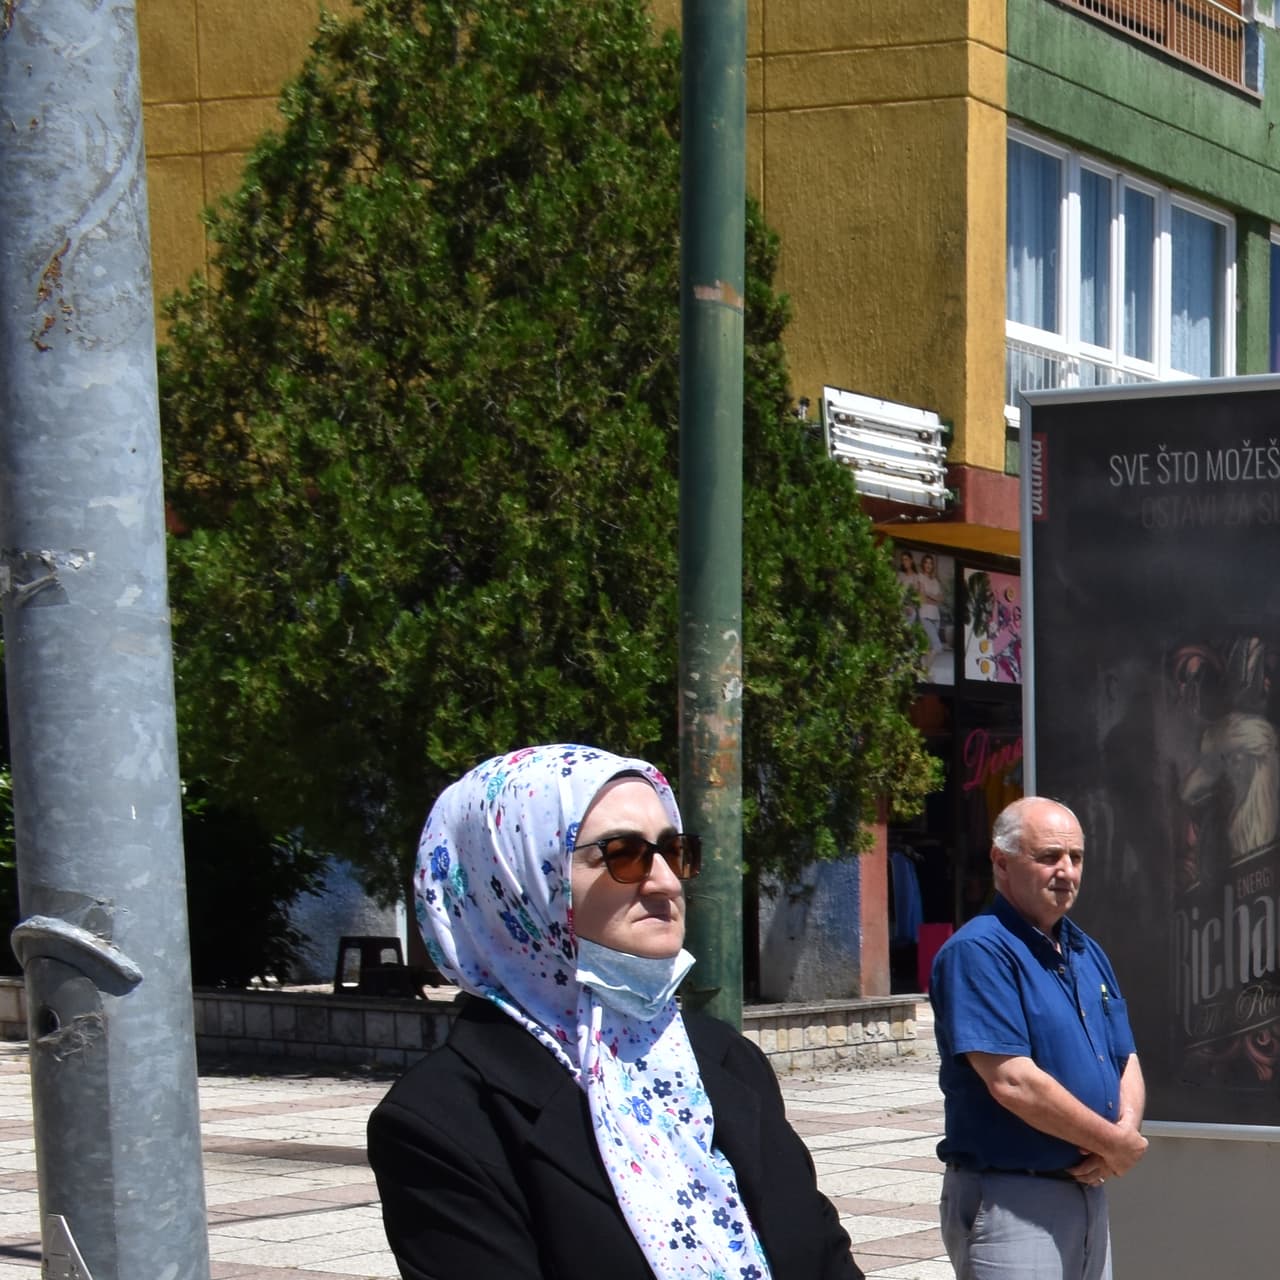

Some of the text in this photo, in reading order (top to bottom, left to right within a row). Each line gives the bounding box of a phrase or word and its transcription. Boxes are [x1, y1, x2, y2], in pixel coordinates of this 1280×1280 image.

[1109, 453, 1150, 487] SVE
[1156, 443, 1199, 485] ŠTO
[1205, 437, 1280, 482] MOŽEŠ
[1141, 495, 1217, 529] OSTAVI
[1223, 492, 1251, 527] ZA
